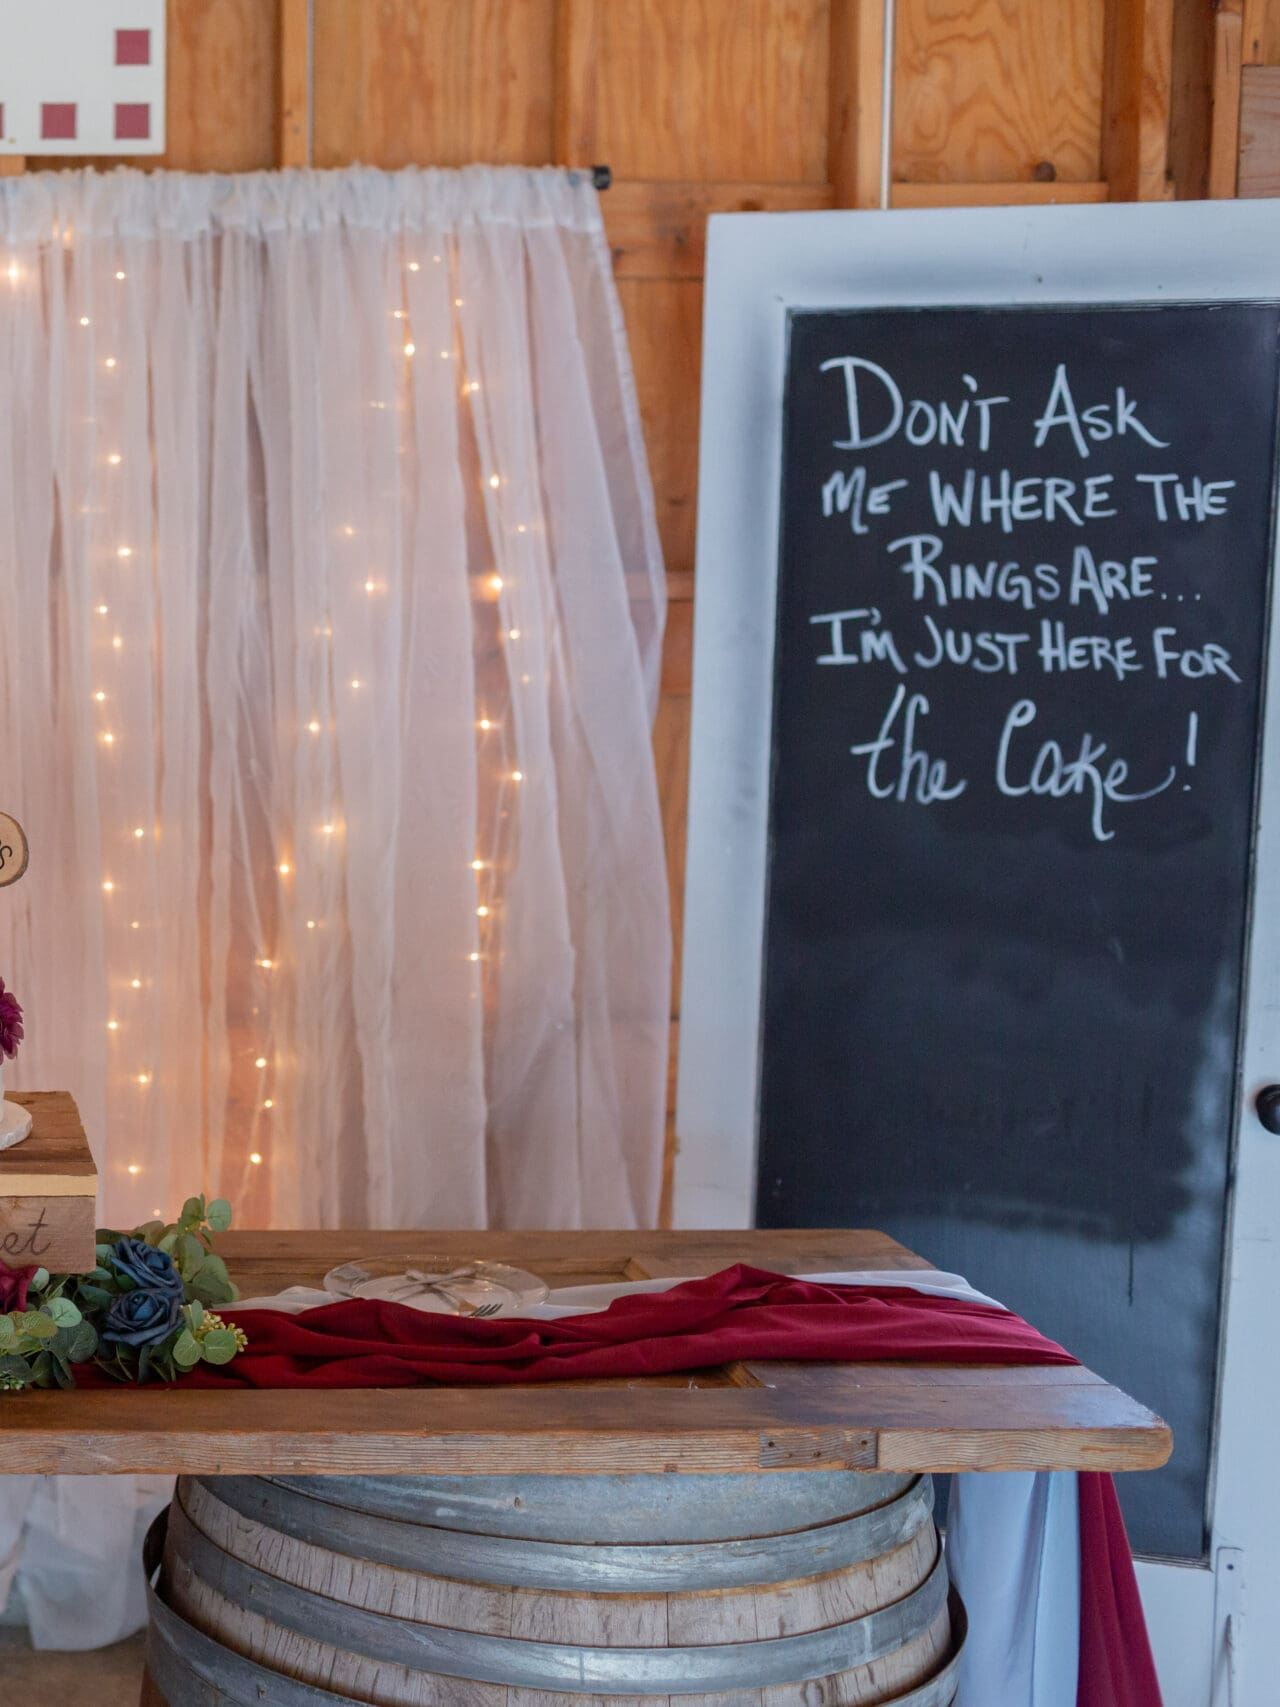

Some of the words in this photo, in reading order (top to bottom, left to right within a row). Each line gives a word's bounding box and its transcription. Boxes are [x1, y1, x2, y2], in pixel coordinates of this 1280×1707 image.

[929, 468, 1118, 533] WHERE
[1135, 473, 1236, 522] THE
[886, 534, 1060, 610] RINGS
[914, 615, 1030, 675] JUST
[1038, 619, 1143, 681] HERE
[1153, 627, 1243, 684] FOR
[850, 683, 967, 804] the
